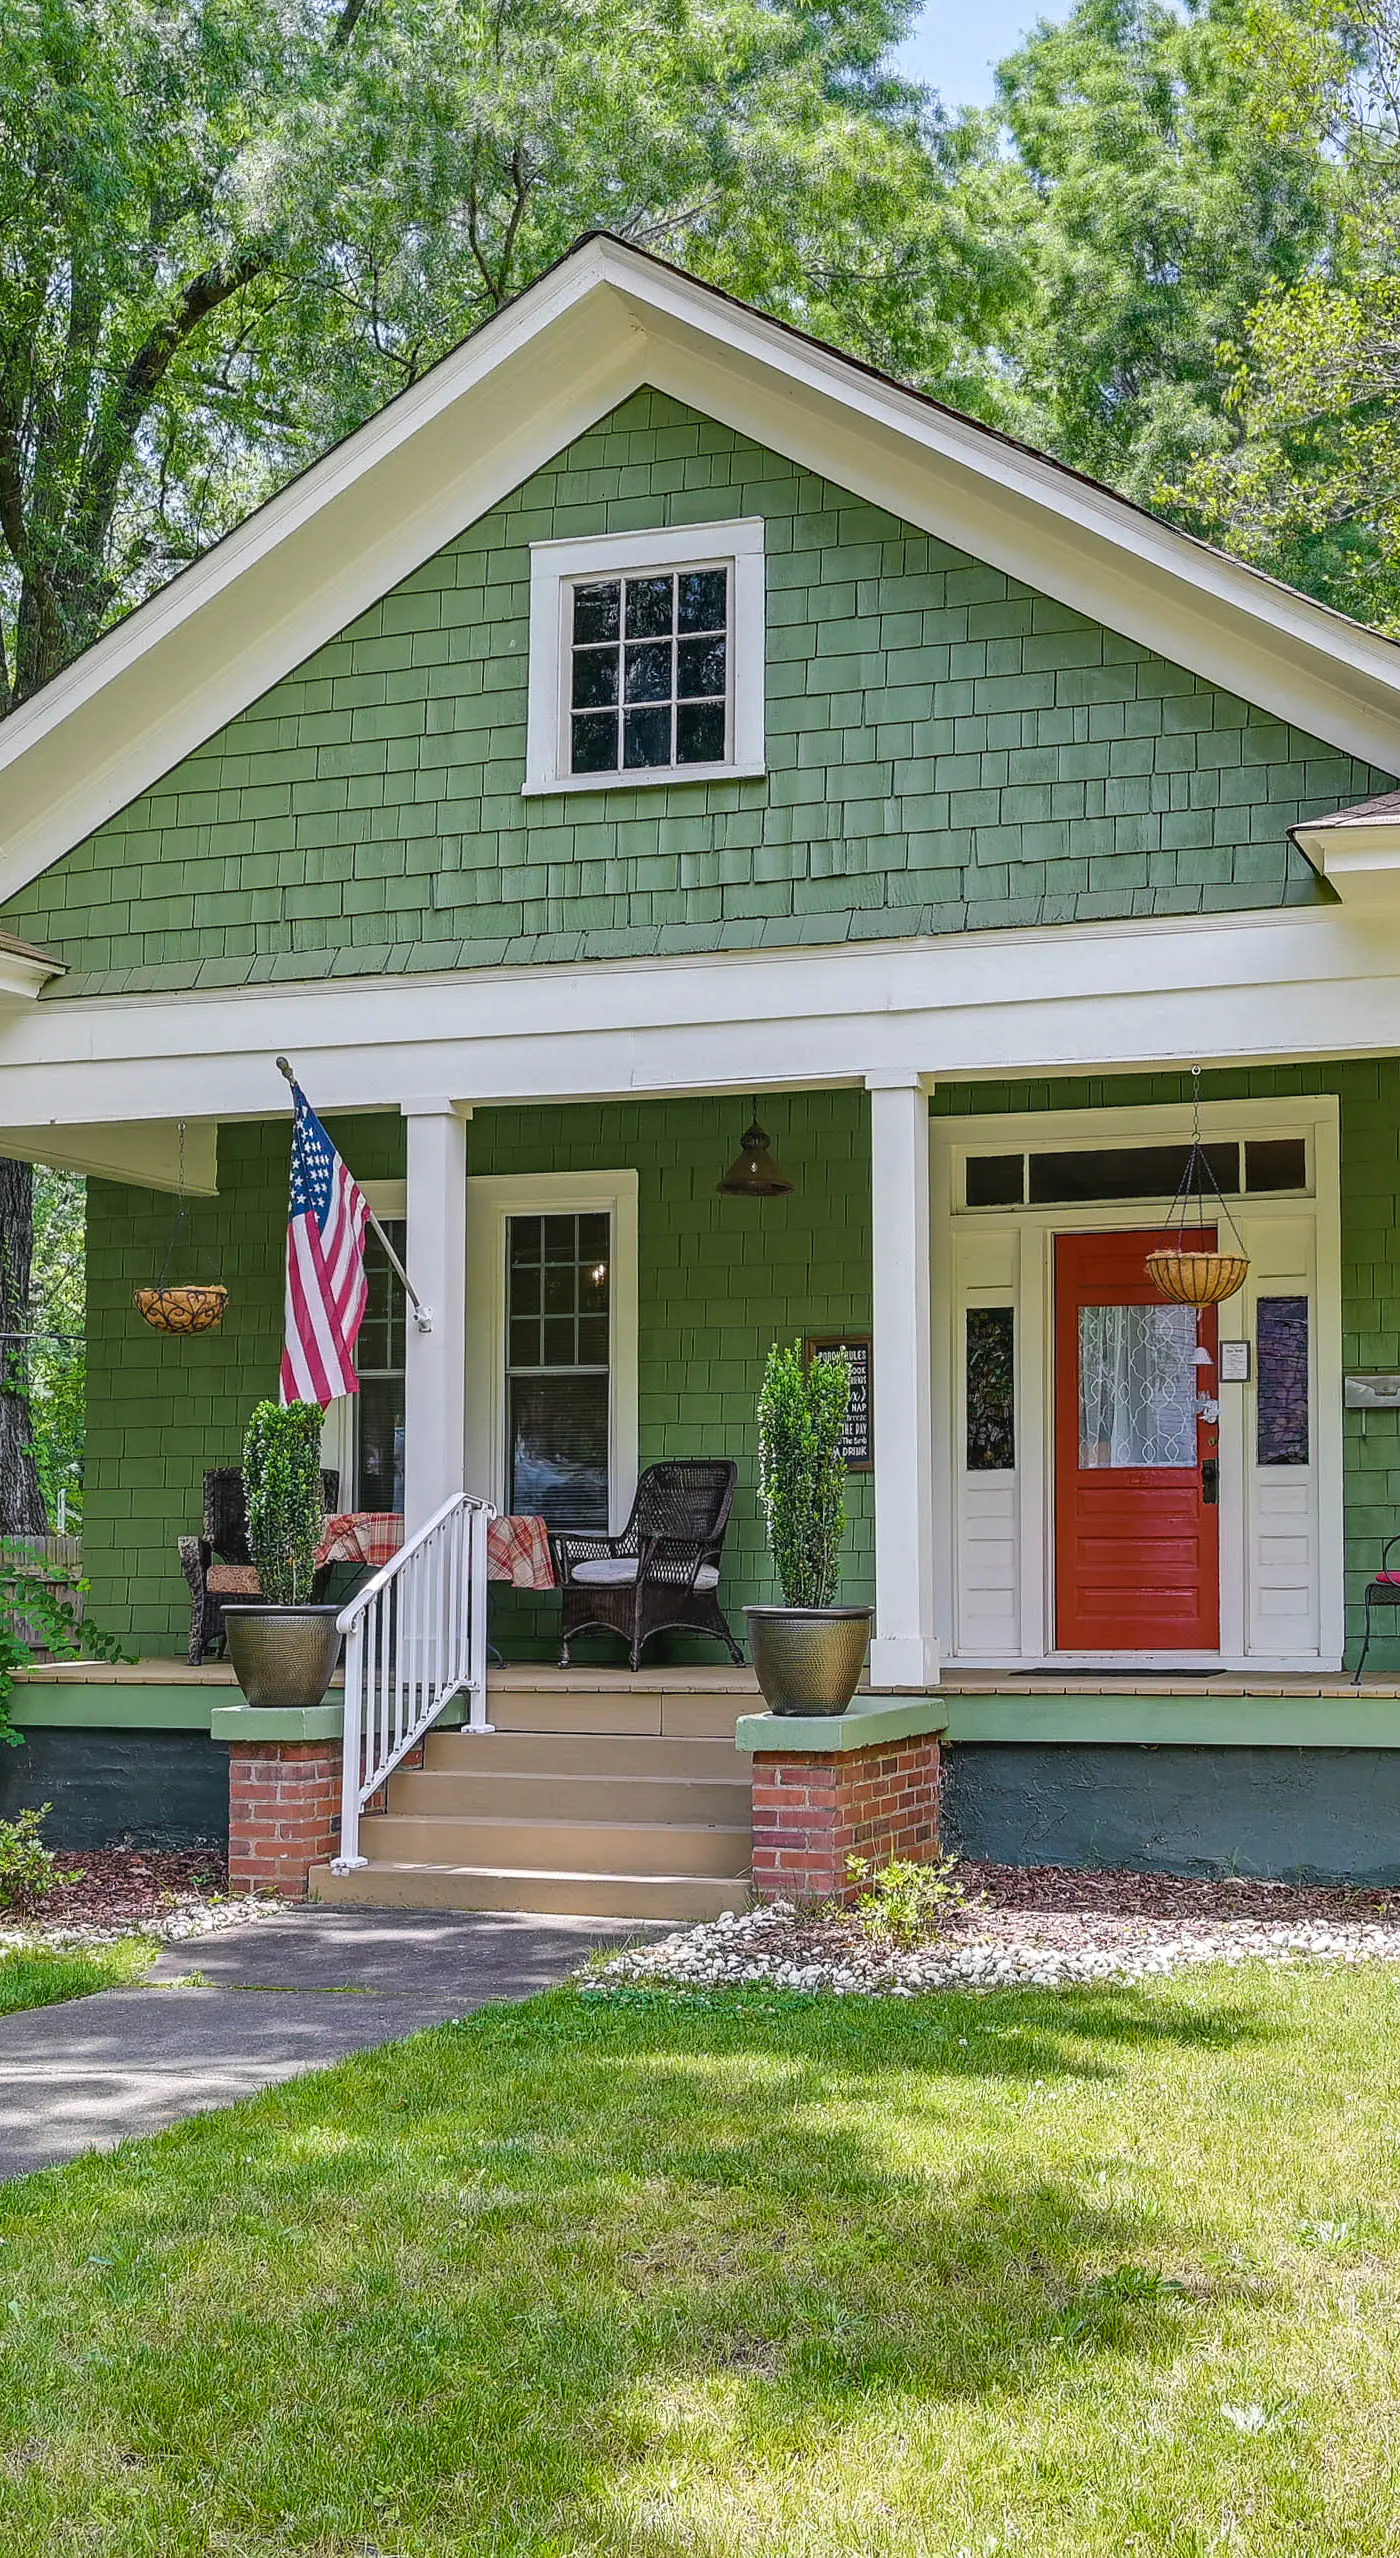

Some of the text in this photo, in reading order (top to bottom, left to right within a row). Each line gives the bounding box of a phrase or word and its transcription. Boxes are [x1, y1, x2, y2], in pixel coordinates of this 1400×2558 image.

[851, 1403, 867, 1412] NAP
[855, 1423, 867, 1436] DAY
[842, 1446, 867, 1457] DRINK
